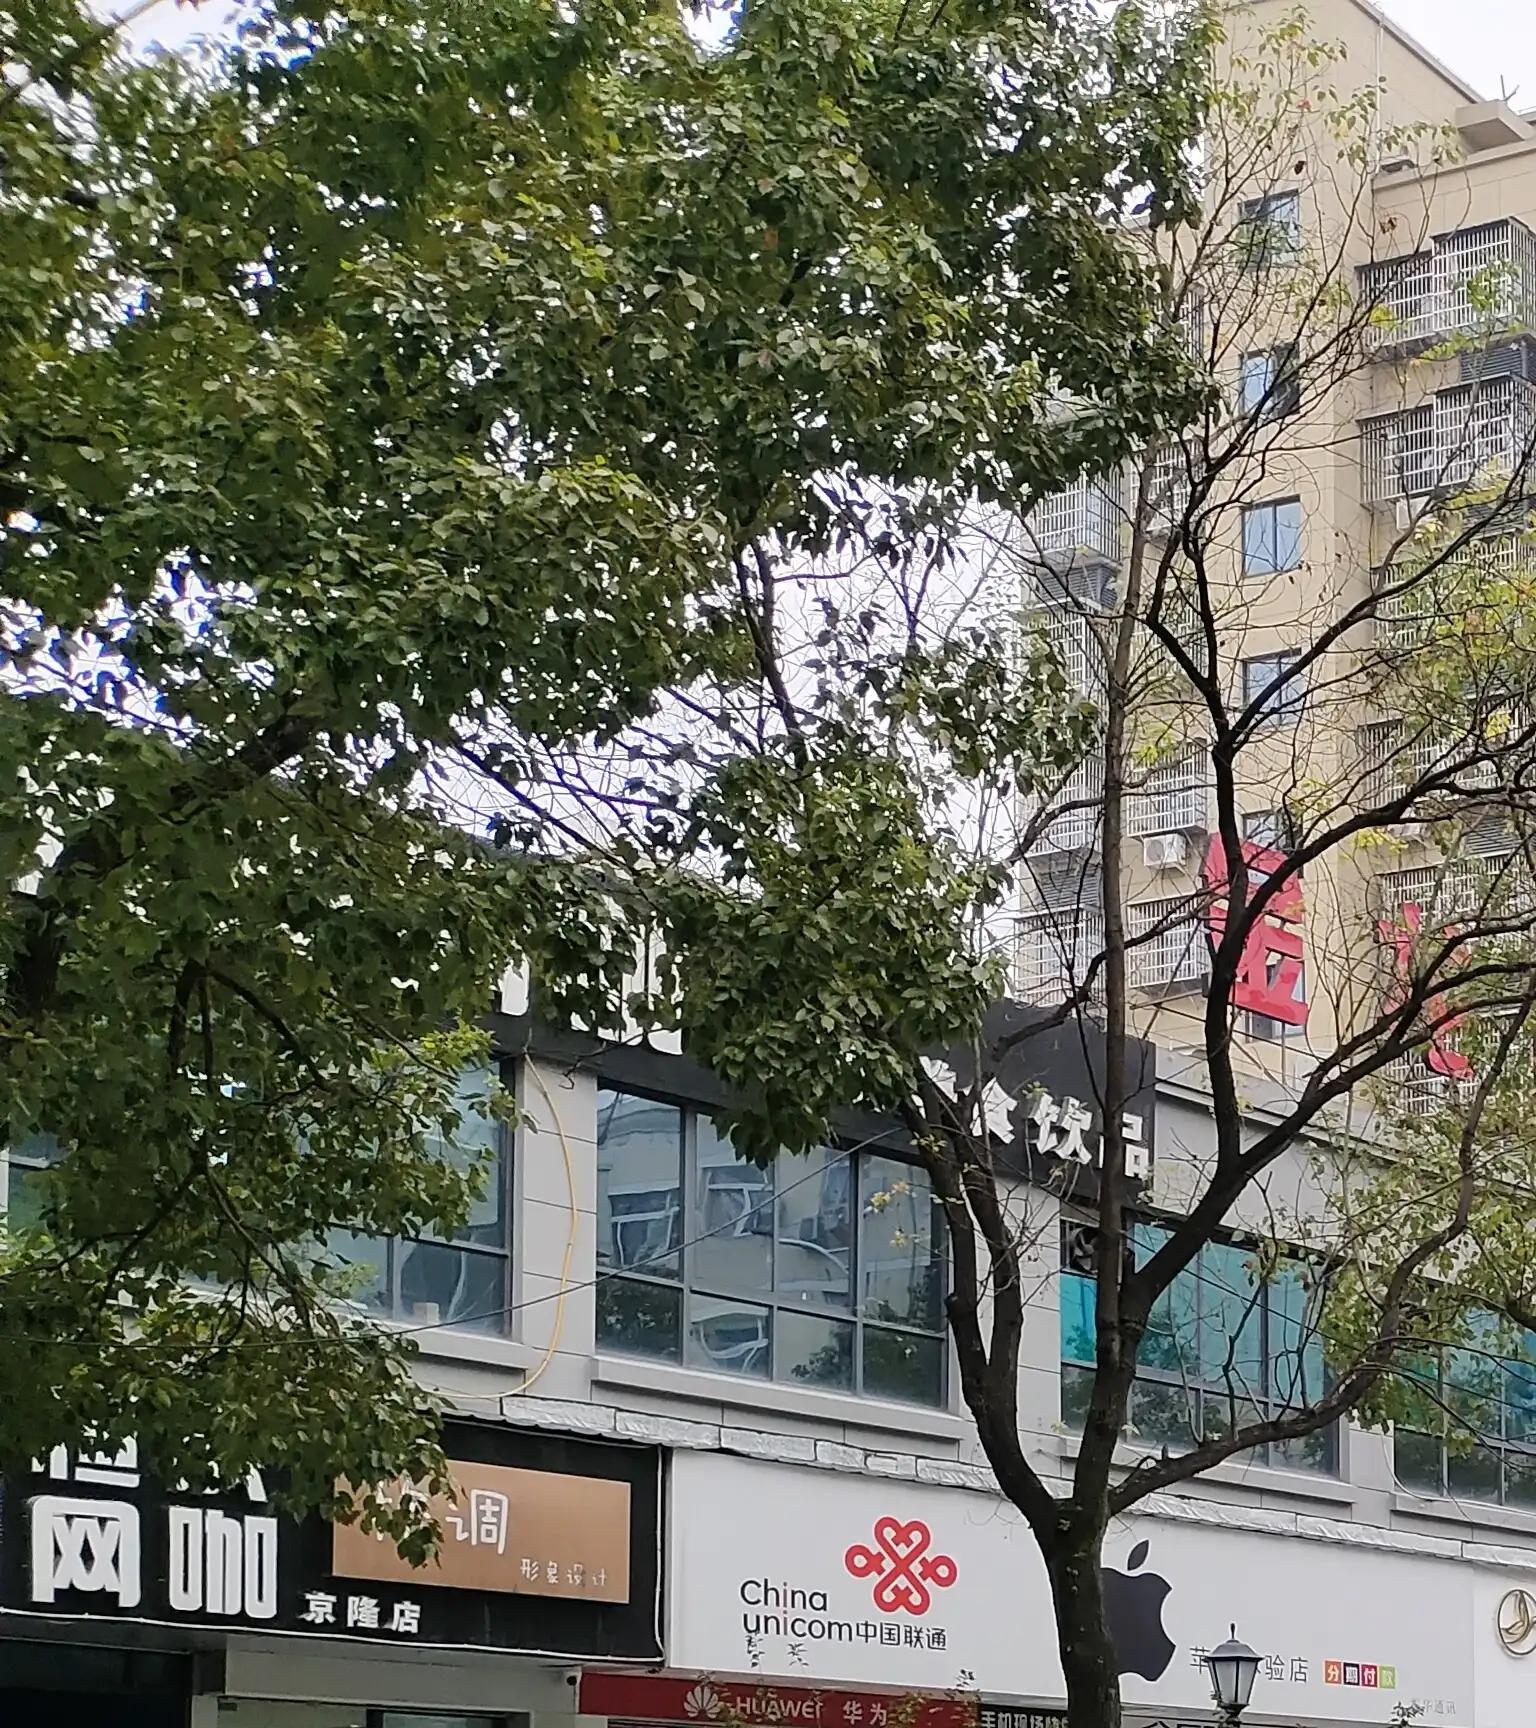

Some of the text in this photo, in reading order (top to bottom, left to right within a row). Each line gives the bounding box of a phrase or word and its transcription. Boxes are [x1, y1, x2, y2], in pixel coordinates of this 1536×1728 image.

[30, 1495, 277, 1618] 网咖
[519, 1557, 608, 1587] 形象设计
[740, 1578, 828, 1611] China
[303, 1592, 421, 1634] 京隆店
[743, 1610, 852, 1641] unicom
[855, 1620, 947, 1650] 中国联通
[1189, 1646, 1308, 1683] 苹验店
[1325, 1661, 1395, 1688] 分期付款
[735, 1697, 823, 1721] HUAWEI
[842, 1703, 888, 1726] 华为
